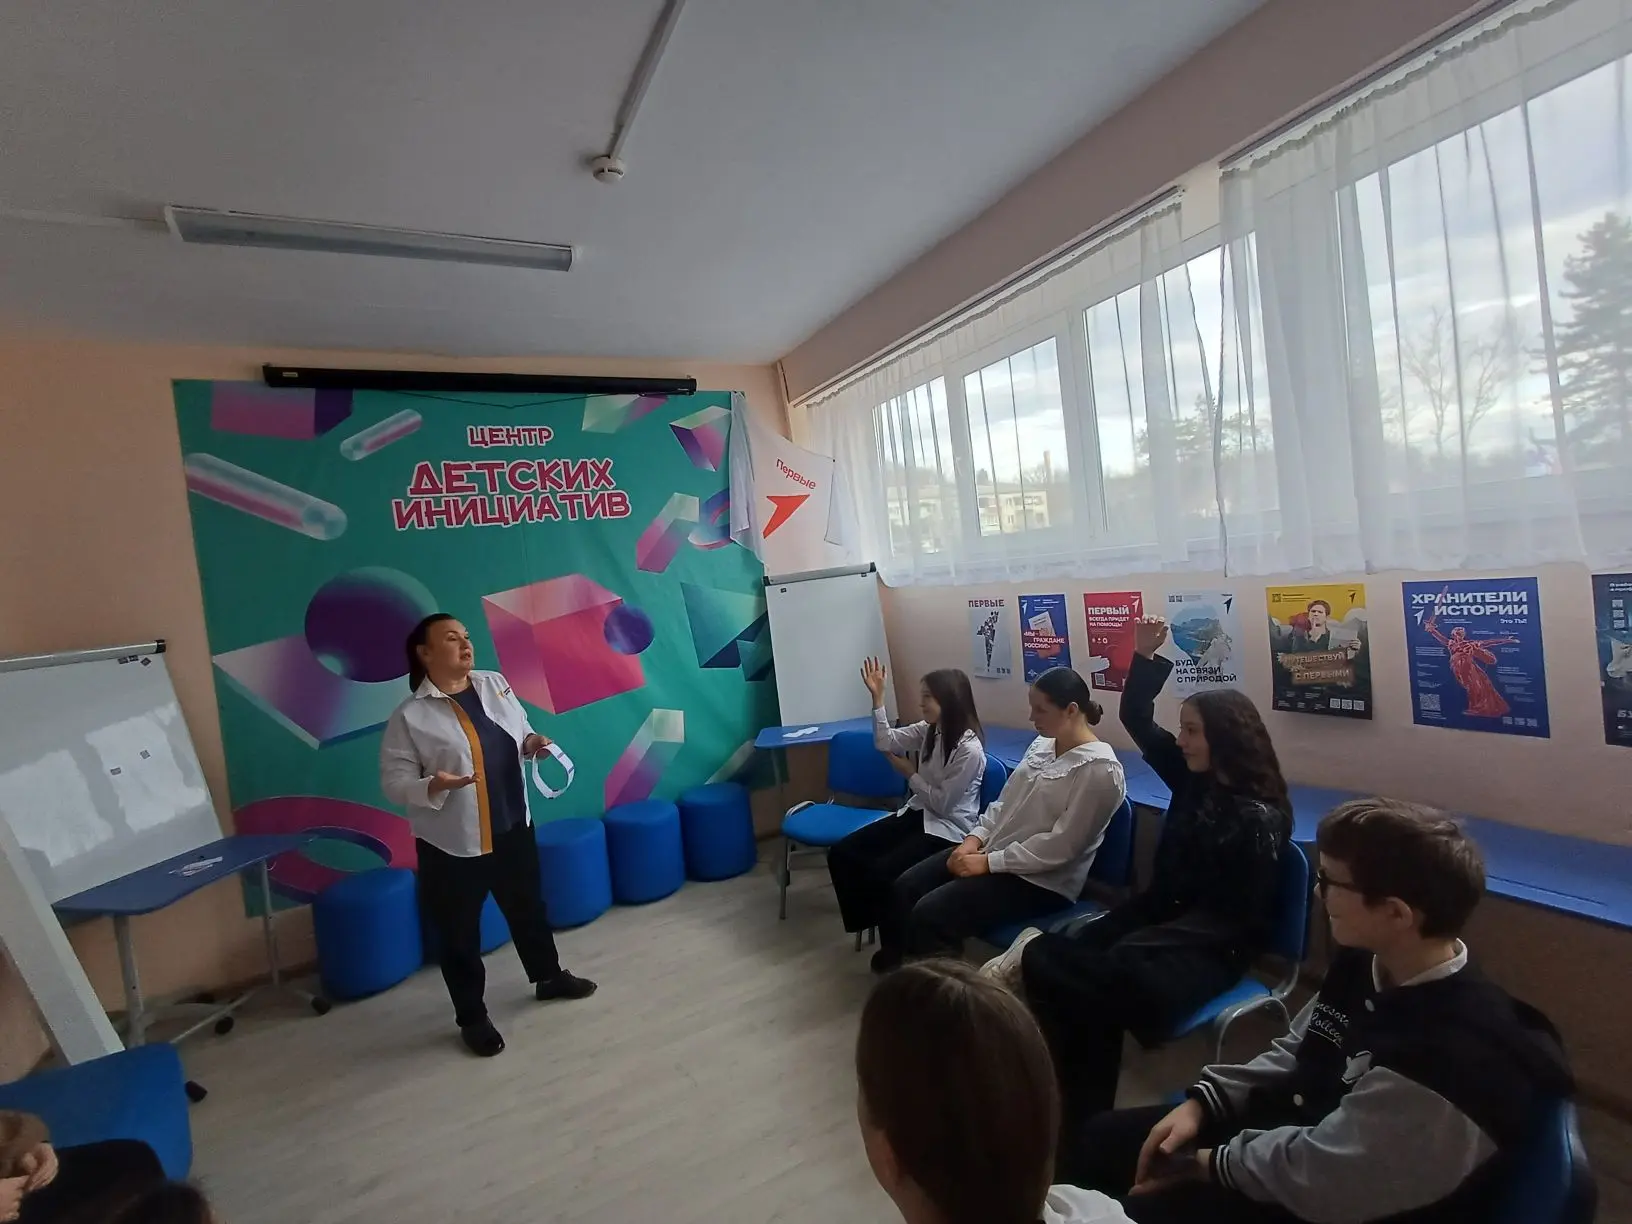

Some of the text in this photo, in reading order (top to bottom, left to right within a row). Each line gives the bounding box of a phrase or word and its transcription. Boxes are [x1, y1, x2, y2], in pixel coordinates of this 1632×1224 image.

[467, 425, 553, 447] ЦЕНТР
[408, 458, 615, 496] ДЕТСКИХ
[776, 458, 816, 490] Первые
[392, 490, 632, 531] ИНИЦИАТИВ
[968, 599, 1005, 608] ПЕРВЫЕ
[1411, 591, 1527, 604] ХРАНИТЕЛИ
[1088, 605, 1130, 615] ПЕРВЫЙ
[1434, 604, 1528, 616] ИСТОРИИ
[1190, 666, 1220, 674] СВЯЗИ
[1185, 674, 1237, 683] ПРИРОДОЙ
